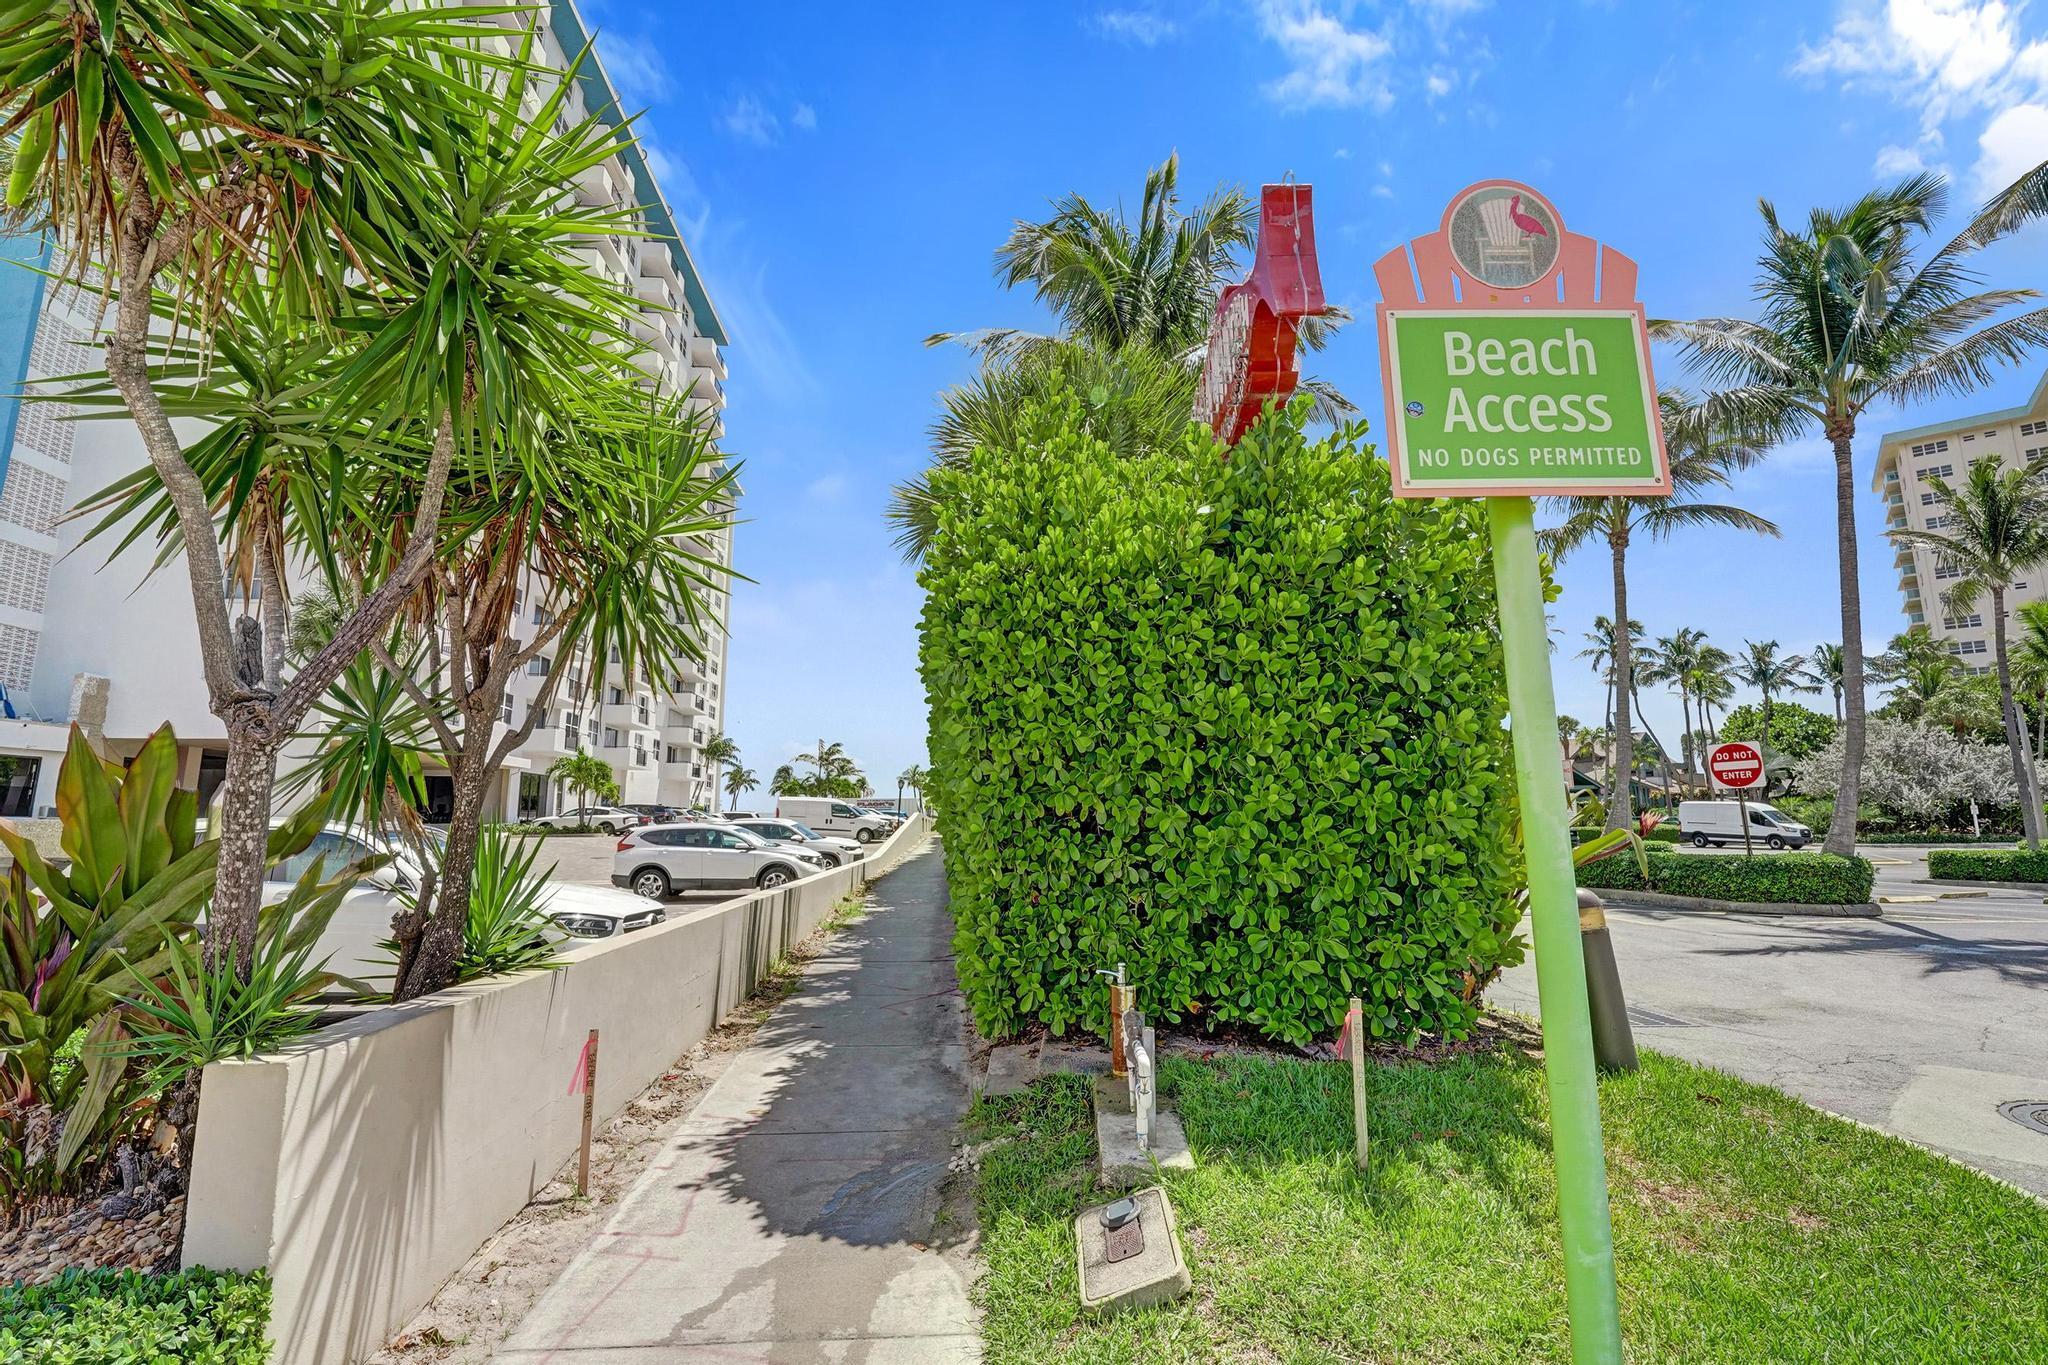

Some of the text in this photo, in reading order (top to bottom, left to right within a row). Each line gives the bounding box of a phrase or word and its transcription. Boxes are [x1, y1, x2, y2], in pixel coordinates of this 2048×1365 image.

[1443, 328, 1598, 376] Beach
[1443, 387, 1613, 433] Access
[1418, 447, 1642, 467] NO DOGS PERMITTED
[1715, 750, 1752, 761] DO NOT
[1722, 771, 1752, 780] ENTER
